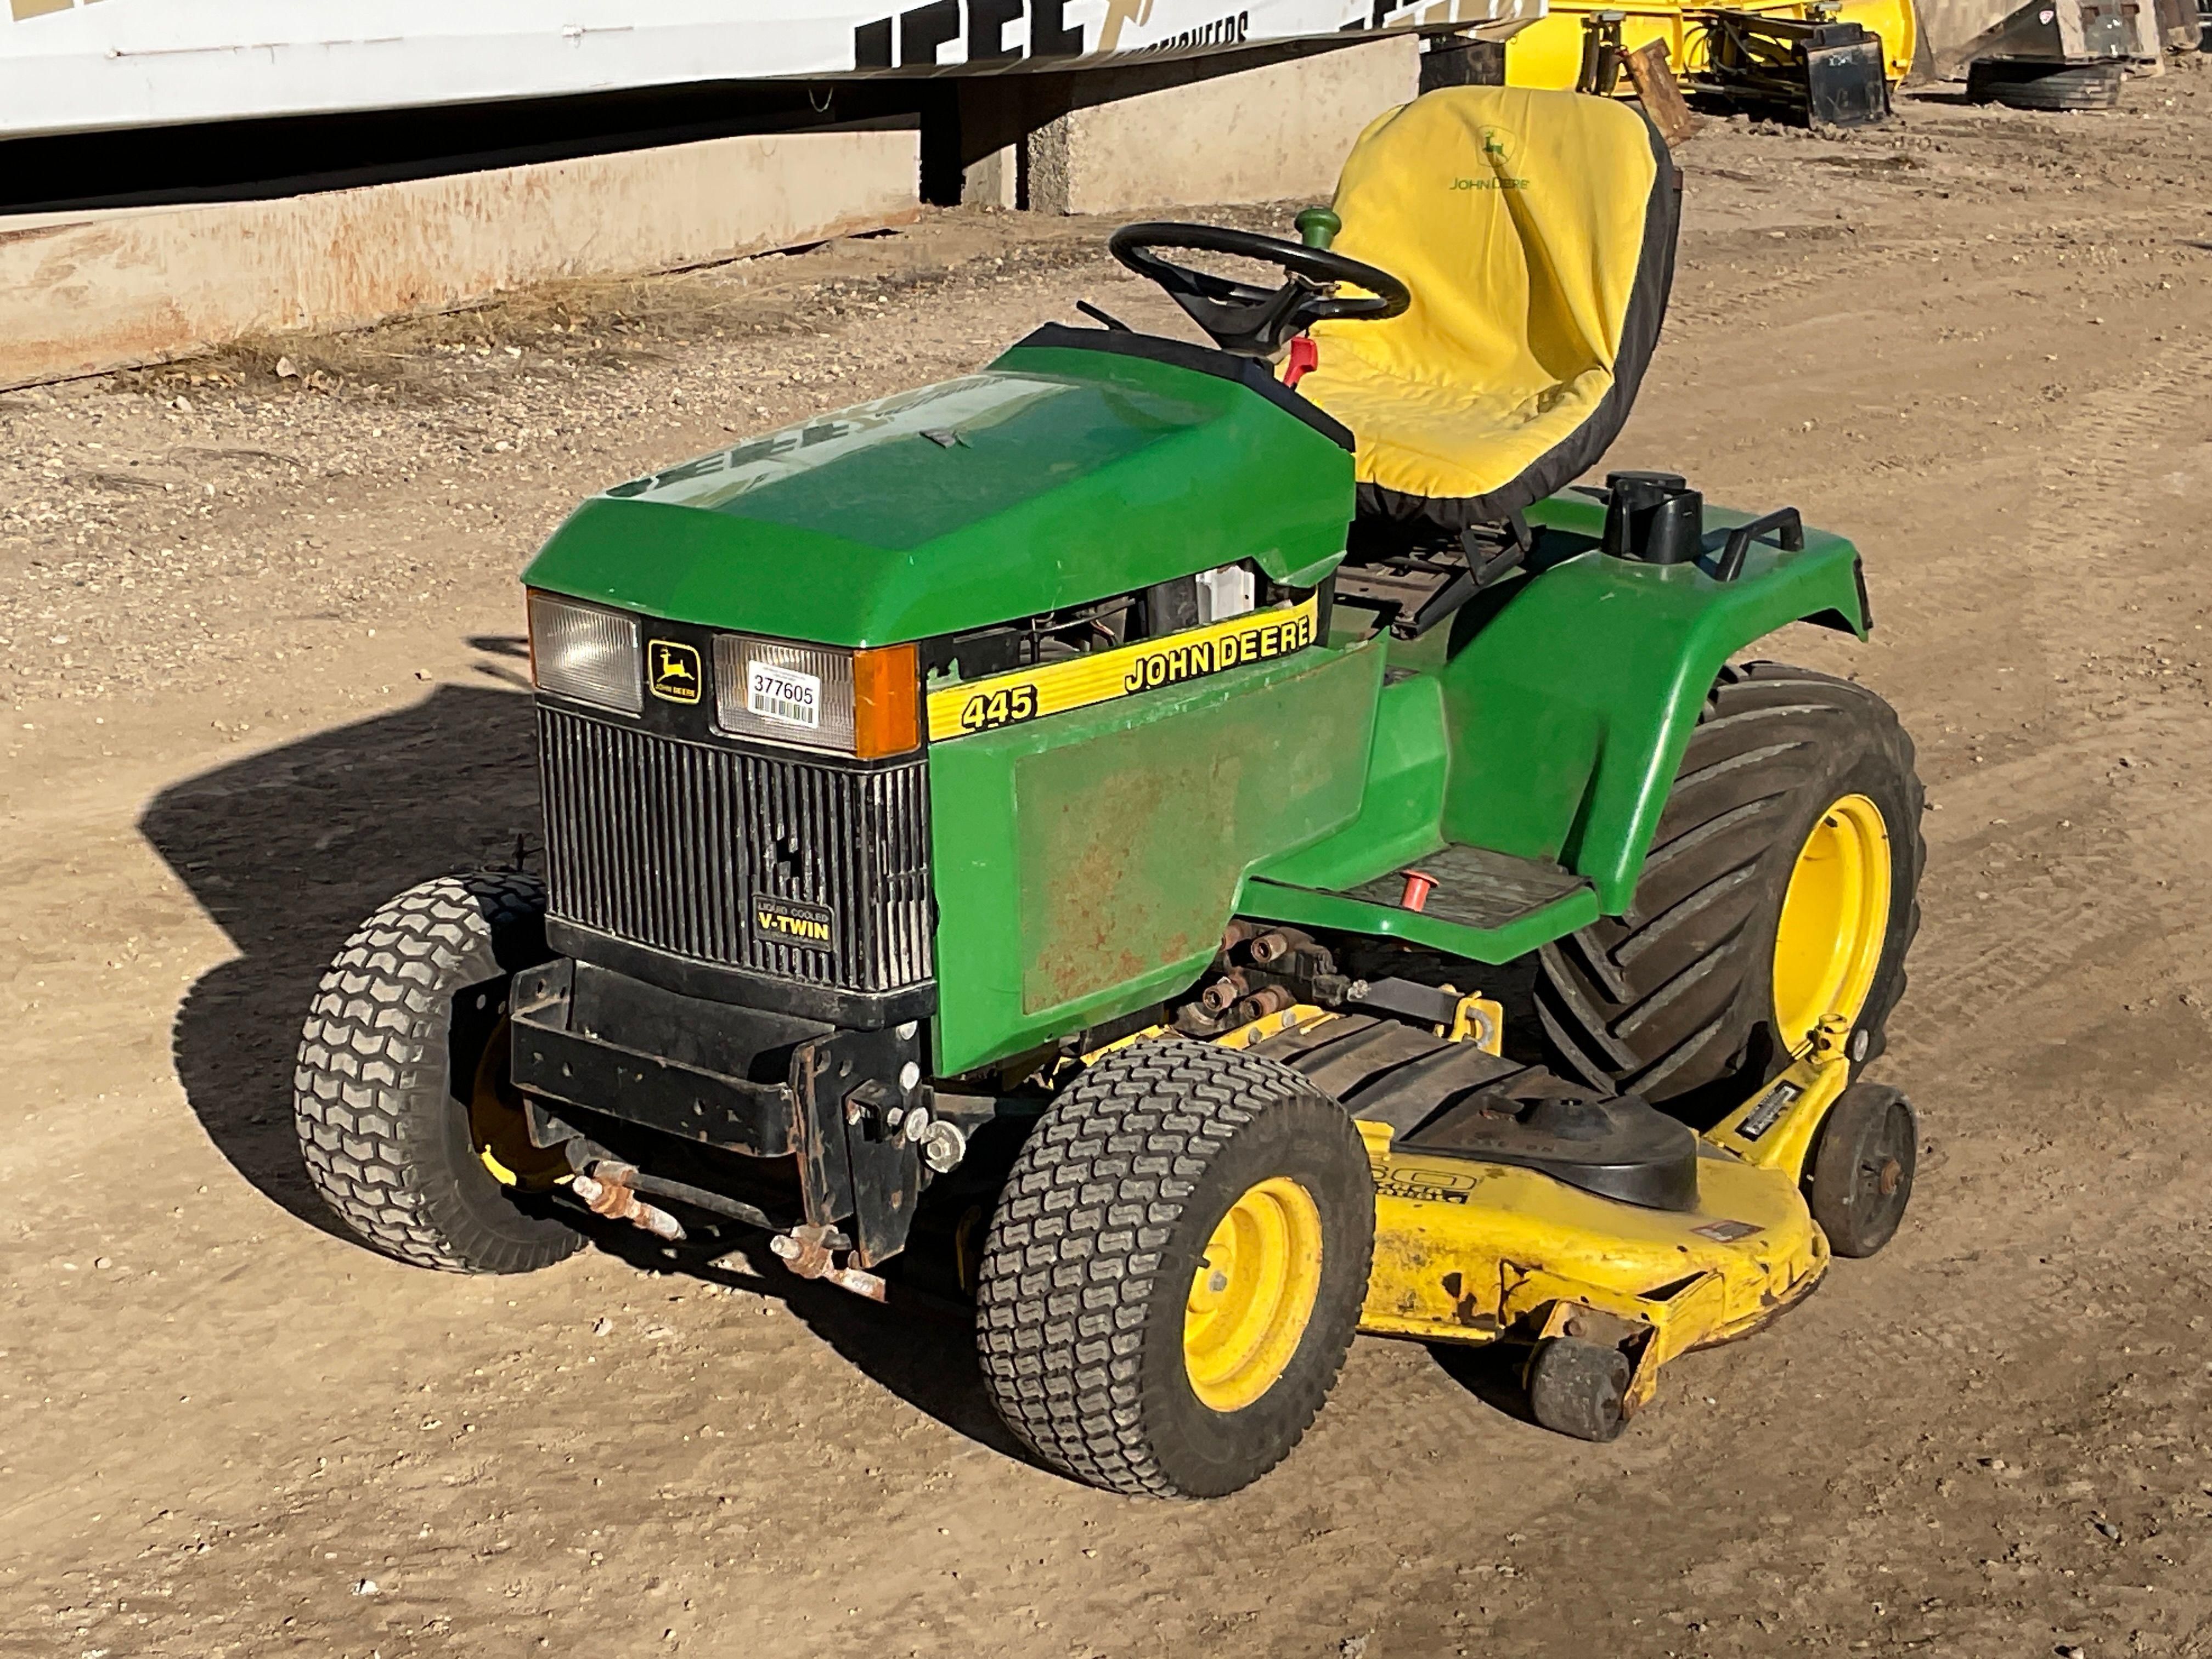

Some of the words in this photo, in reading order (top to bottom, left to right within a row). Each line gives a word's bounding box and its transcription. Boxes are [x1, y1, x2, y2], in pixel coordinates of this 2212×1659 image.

[1449, 177, 1489, 190] JOHN
[1124, 643, 1214, 694] JOHN
[1218, 615, 1311, 669] DEERE
[754, 674, 813, 704] 377605
[961, 685, 1037, 731] 445
